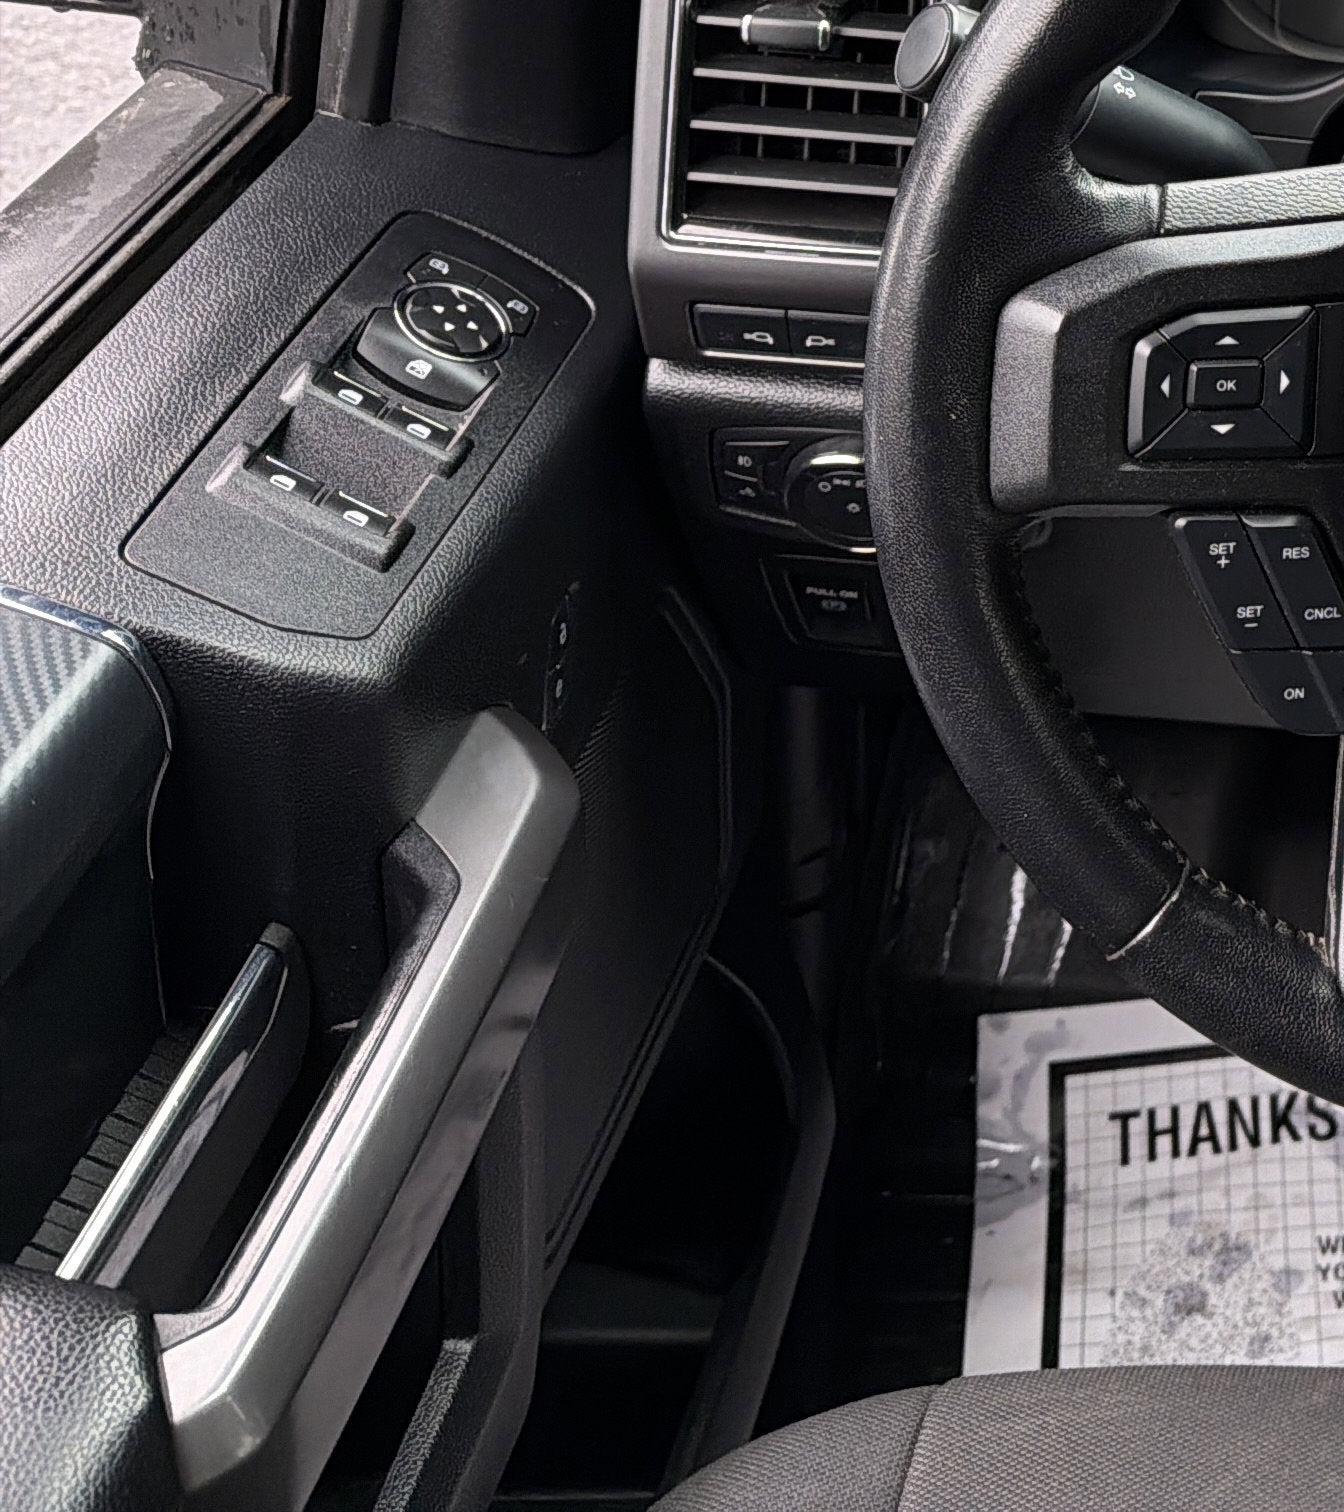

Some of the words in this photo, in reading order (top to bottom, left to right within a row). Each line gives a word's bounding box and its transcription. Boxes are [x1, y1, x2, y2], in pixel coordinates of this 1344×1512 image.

[1215, 378, 1237, 394] OK
[1209, 541, 1237, 558] SET
[1282, 544, 1311, 562] RES
[805, 586, 837, 598] PULL
[1236, 605, 1264, 621] SET
[1303, 605, 1342, 622] CNCL
[1283, 685, 1305, 702] ON
[1107, 1090, 1340, 1168] THANKS
